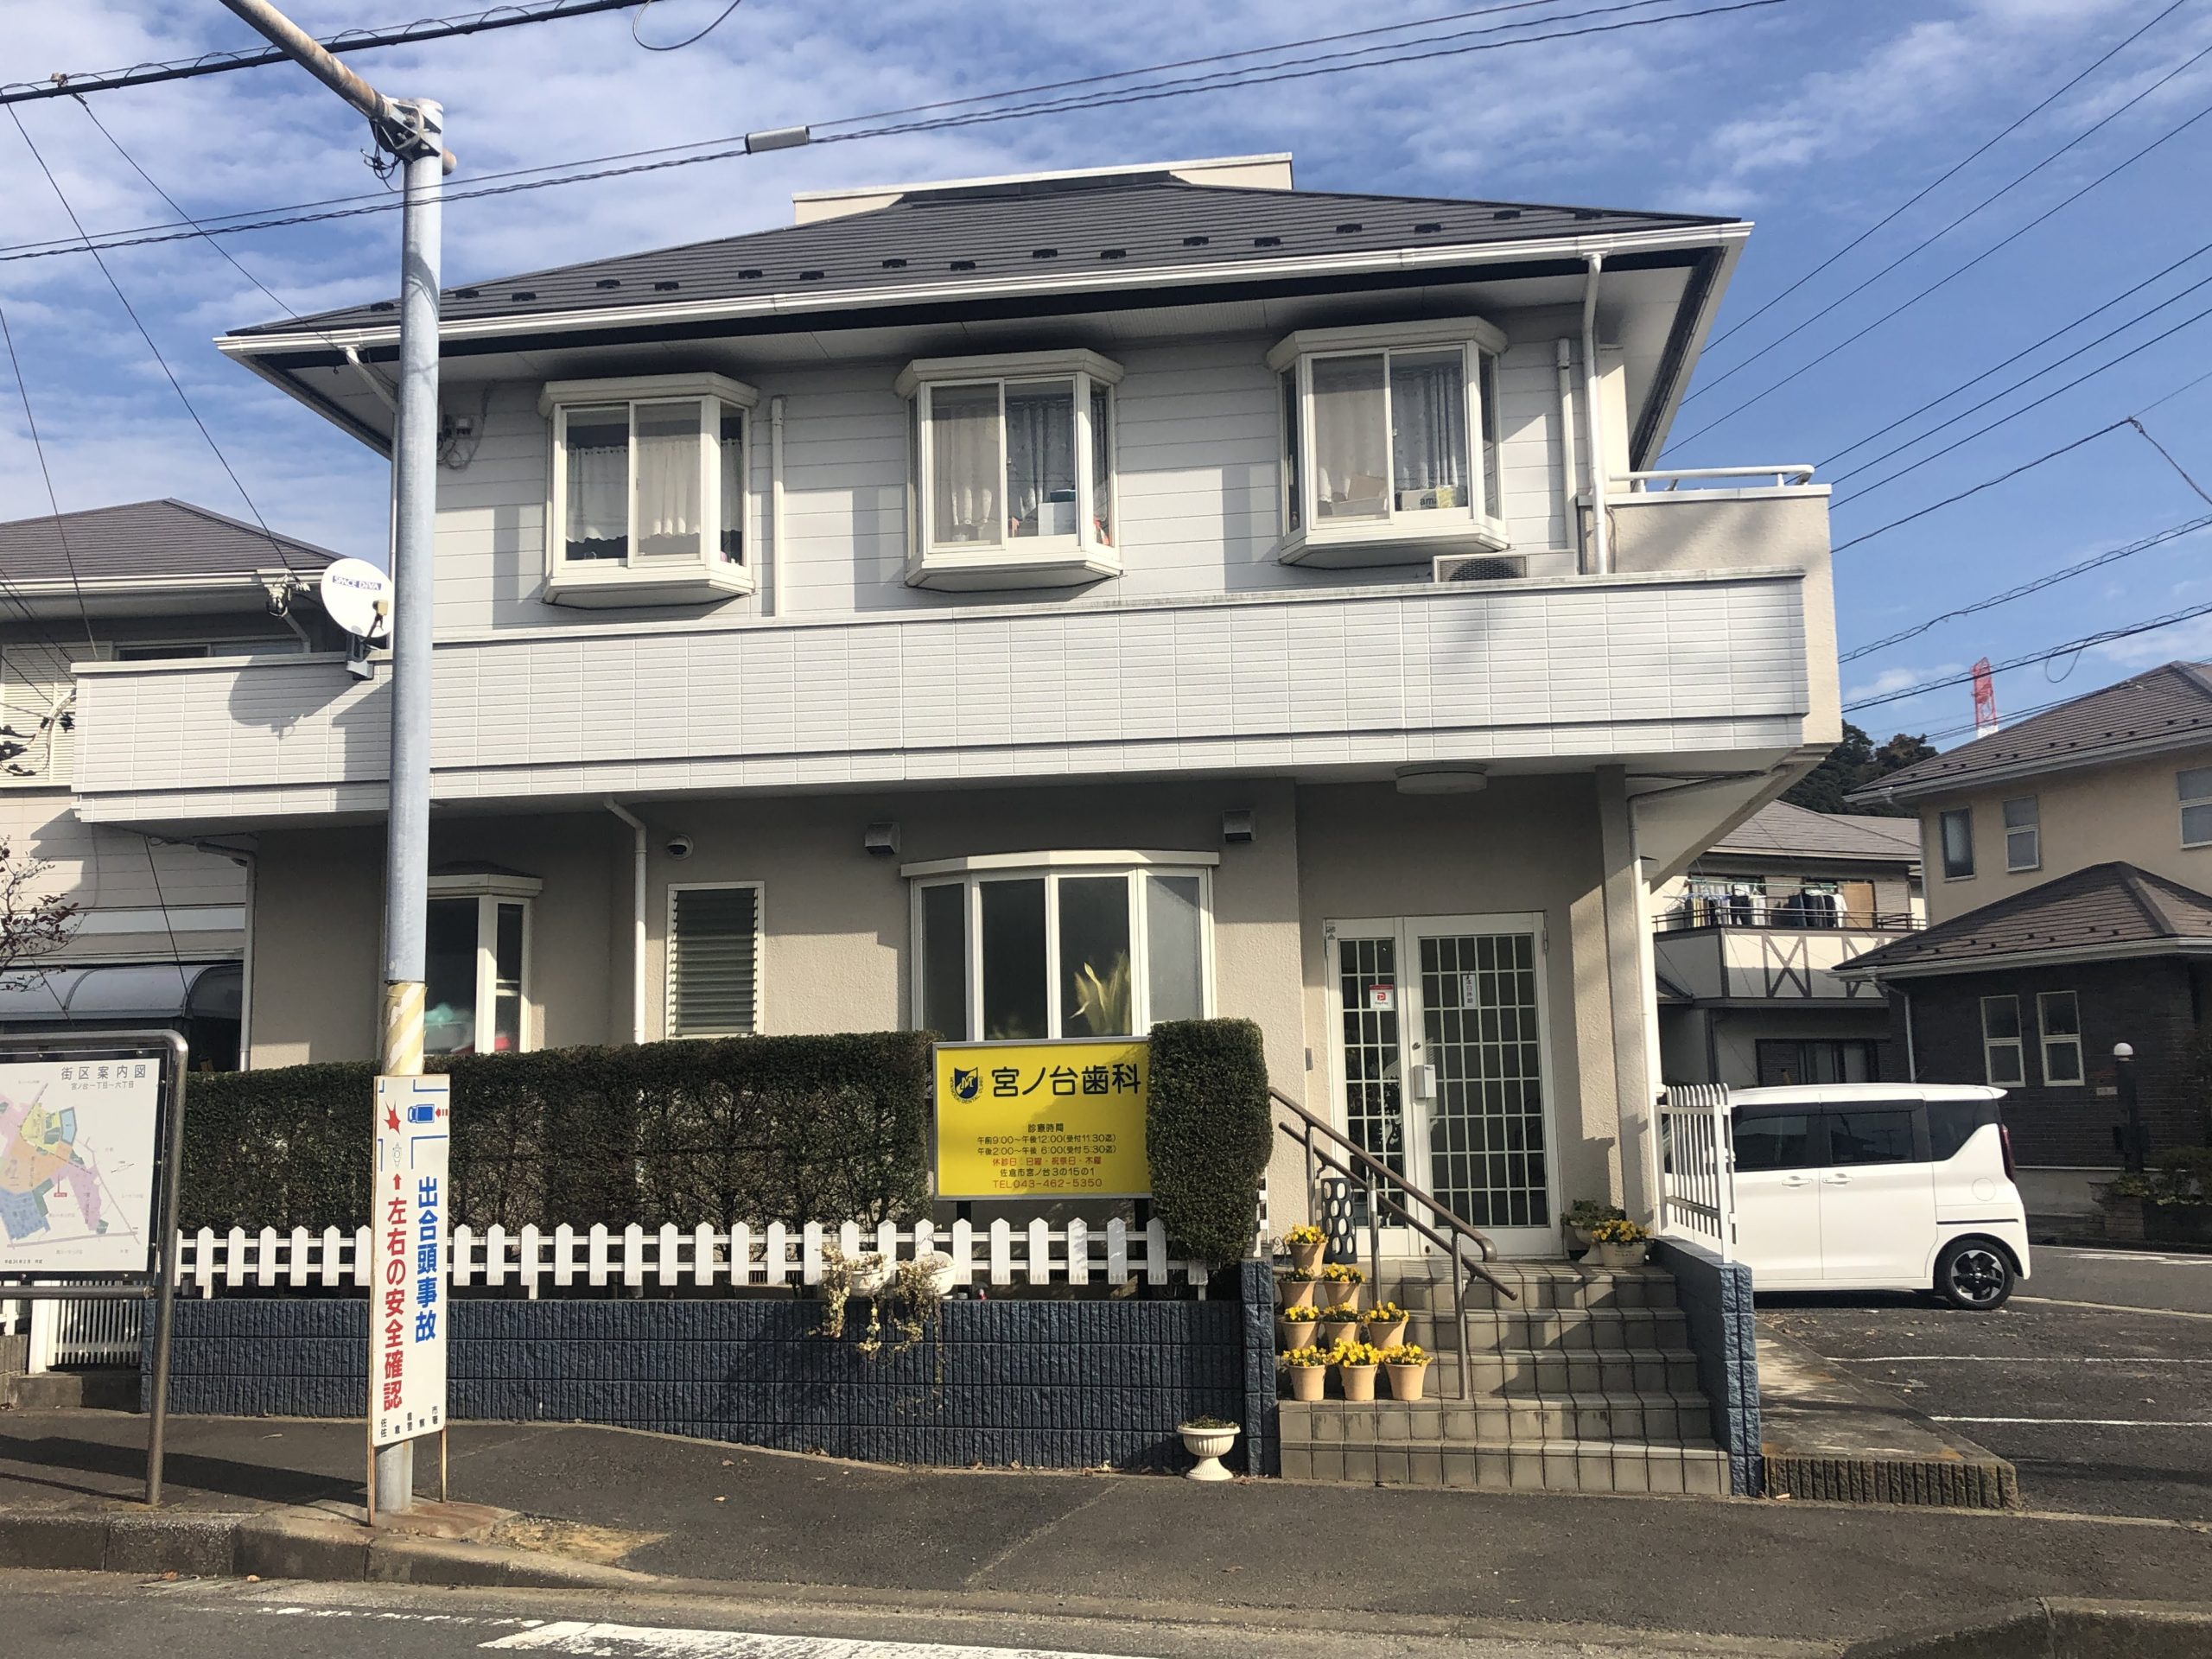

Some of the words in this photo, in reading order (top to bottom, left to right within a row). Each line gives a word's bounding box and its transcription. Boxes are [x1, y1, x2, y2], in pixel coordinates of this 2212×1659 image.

[61, 1065, 146, 1080] 街区案内図
[991, 1063, 1141, 1097] 宮ノ台歯科
[1027, 1123, 1065, 1133] 診療時間
[416, 1176, 438, 1344] 出合頭事故
[383, 1197, 407, 1412] 左右の安全確認
